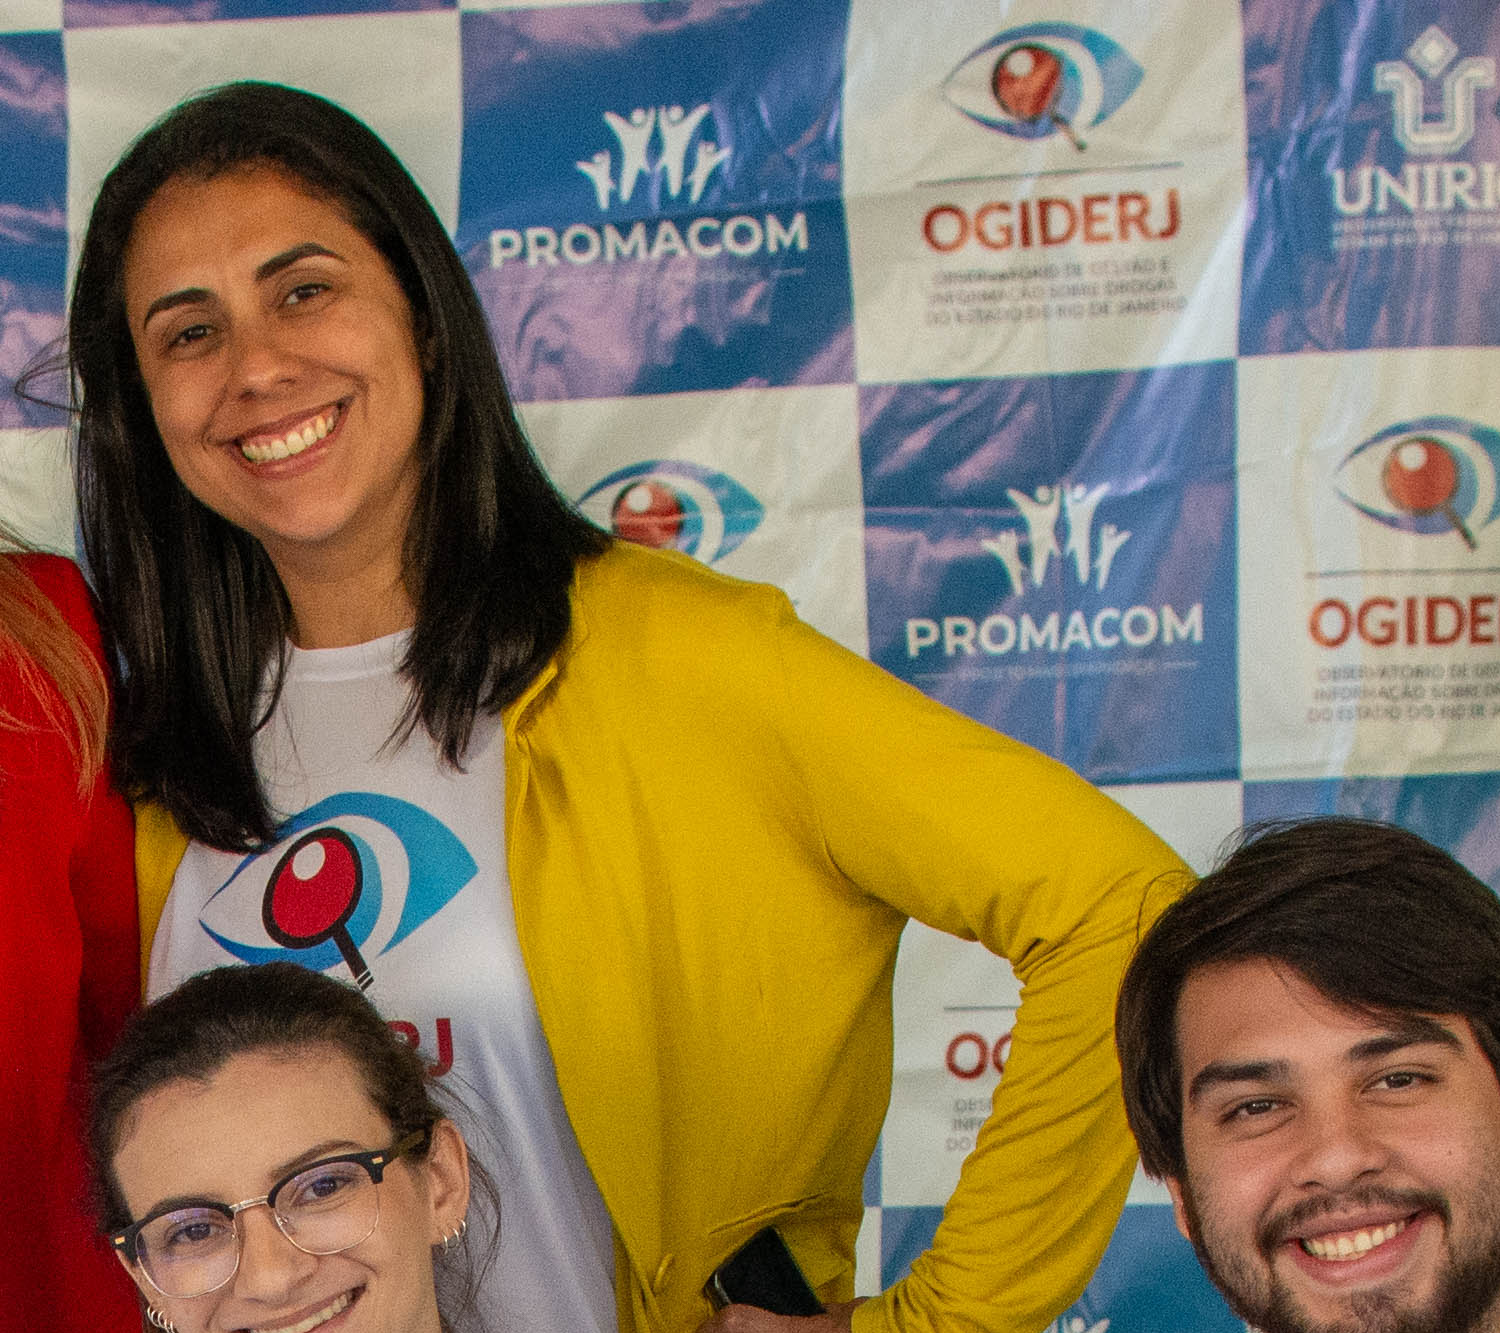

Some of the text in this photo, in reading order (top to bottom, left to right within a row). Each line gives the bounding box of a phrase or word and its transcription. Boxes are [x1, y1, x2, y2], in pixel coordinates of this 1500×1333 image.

[490, 212, 806, 268] PROMACOM
[922, 187, 1182, 254] OGIDERJ
[905, 604, 1203, 658] PROMACOM
